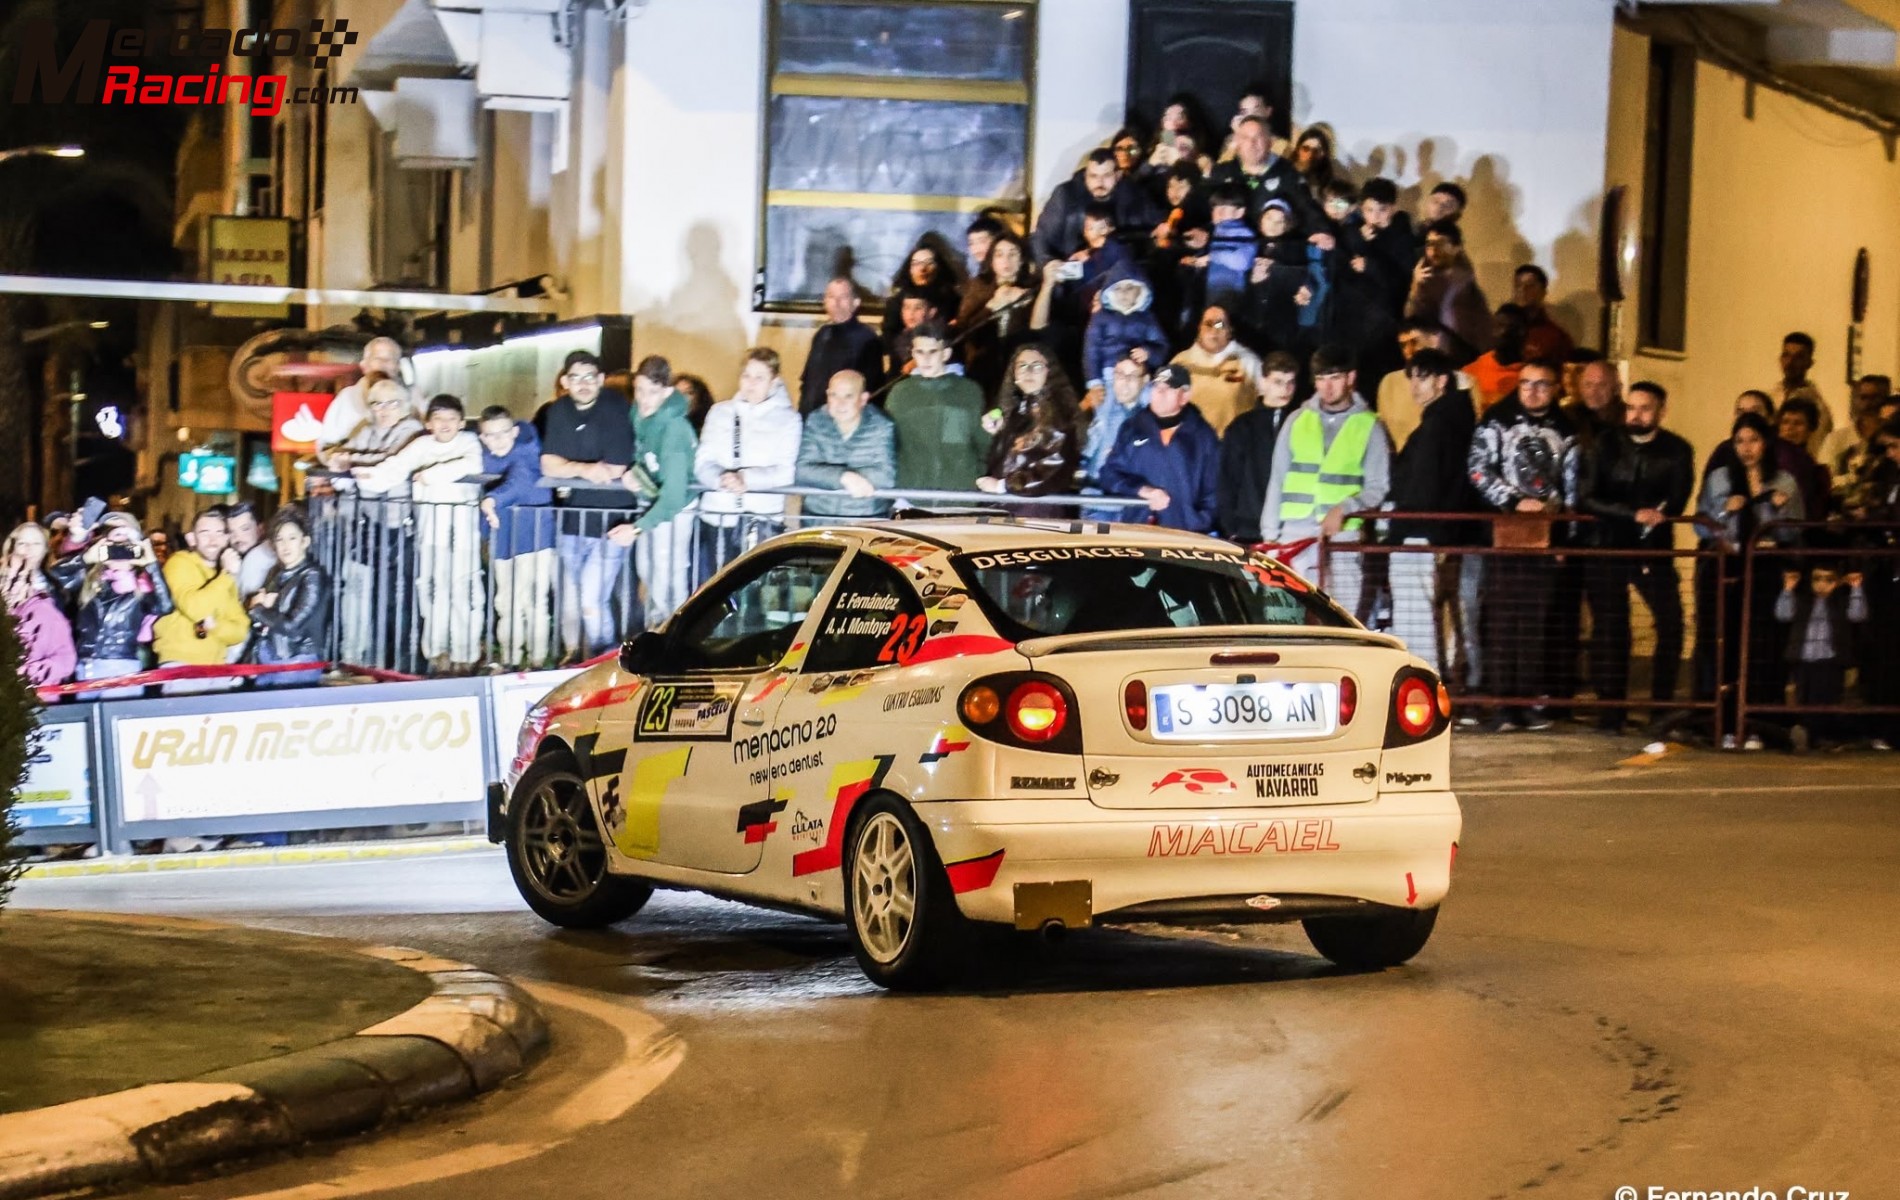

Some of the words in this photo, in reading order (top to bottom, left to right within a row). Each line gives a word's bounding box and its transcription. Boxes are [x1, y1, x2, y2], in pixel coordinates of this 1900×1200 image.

[972, 547, 1145, 570] DESGUACES
[836, 592, 847, 609] E.
[847, 592, 900, 611] Fernández
[847, 617, 892, 639] Montoya
[877, 613, 927, 667] 23
[644, 686, 676, 731] 23
[1177, 698, 1193, 726] S
[1208, 695, 1273, 725] 3098
[1286, 693, 1317, 723] AN
[750, 768, 768, 786] new
[789, 751, 824, 774] dentist
[1247, 763, 1324, 778] AUTOMECANICAS
[1256, 777, 1319, 798] NAVARRO
[1148, 819, 1340, 858] MACAEL
